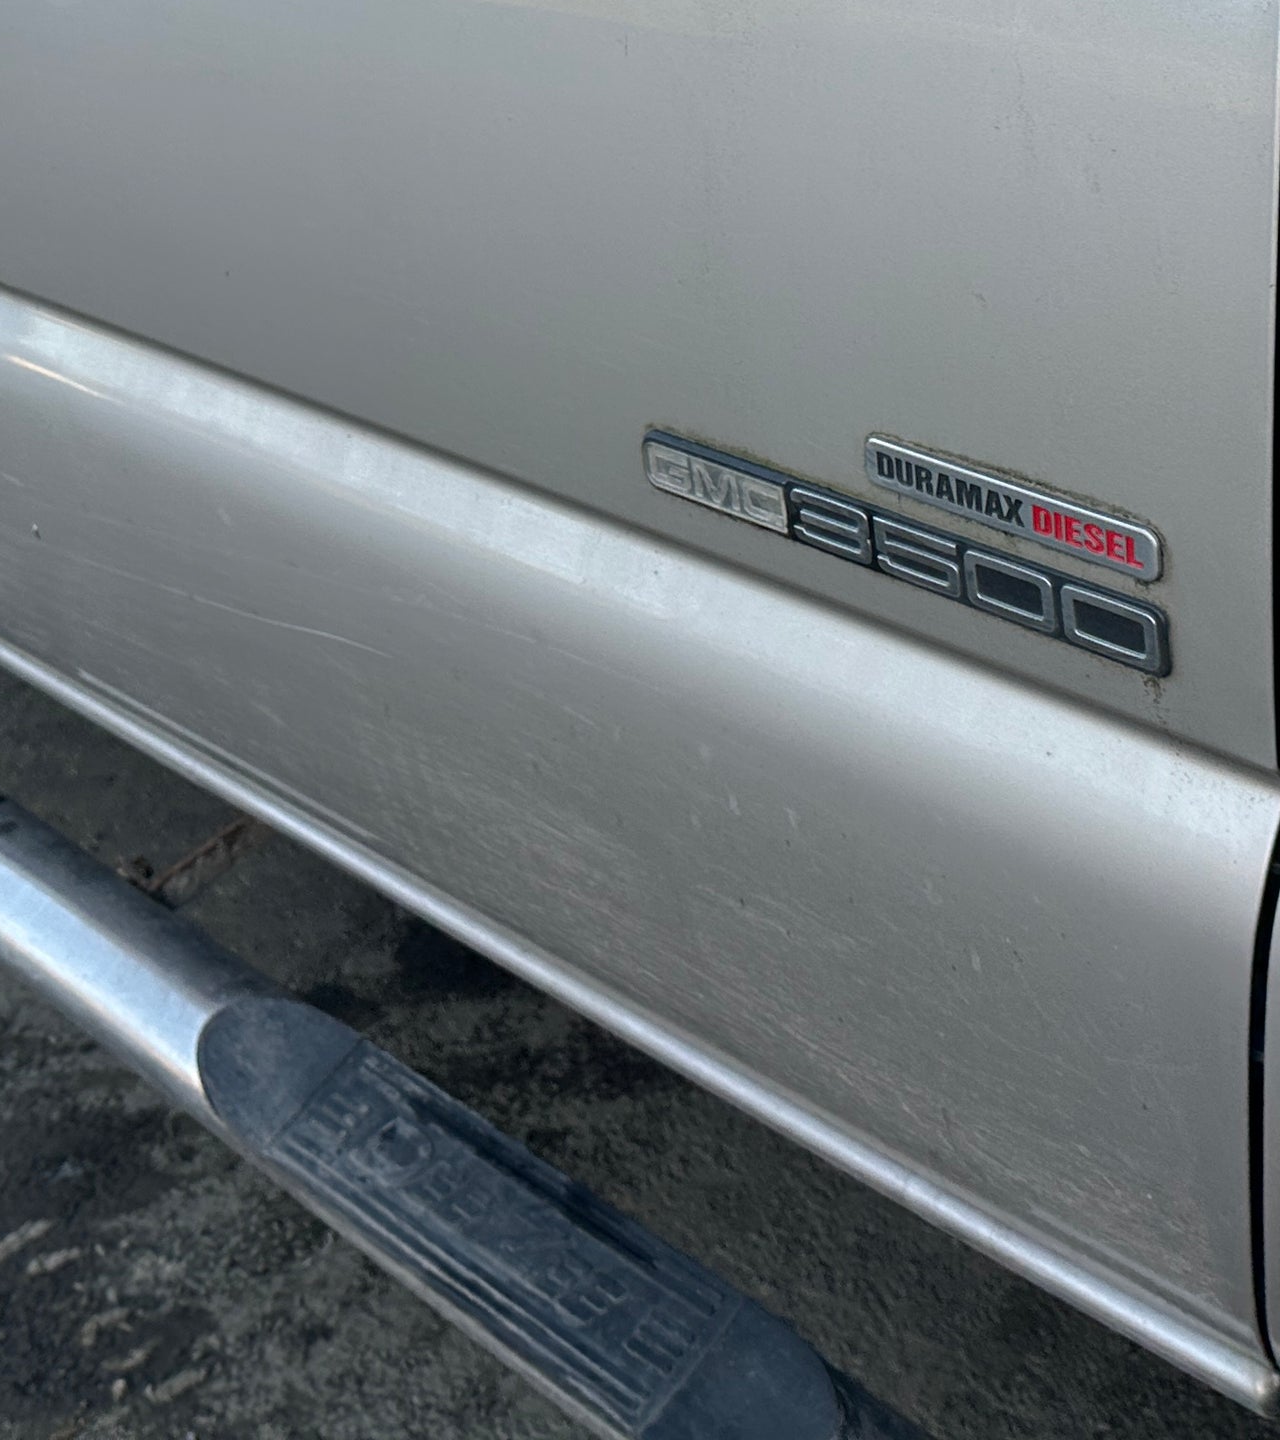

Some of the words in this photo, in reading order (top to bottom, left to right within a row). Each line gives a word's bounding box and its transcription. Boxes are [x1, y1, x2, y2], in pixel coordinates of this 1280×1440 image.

[646, 448, 786, 526] GMC
[789, 489, 1159, 666] 3500
[875, 450, 1025, 528] DURAMAX
[1030, 504, 1144, 570] DIESEL
